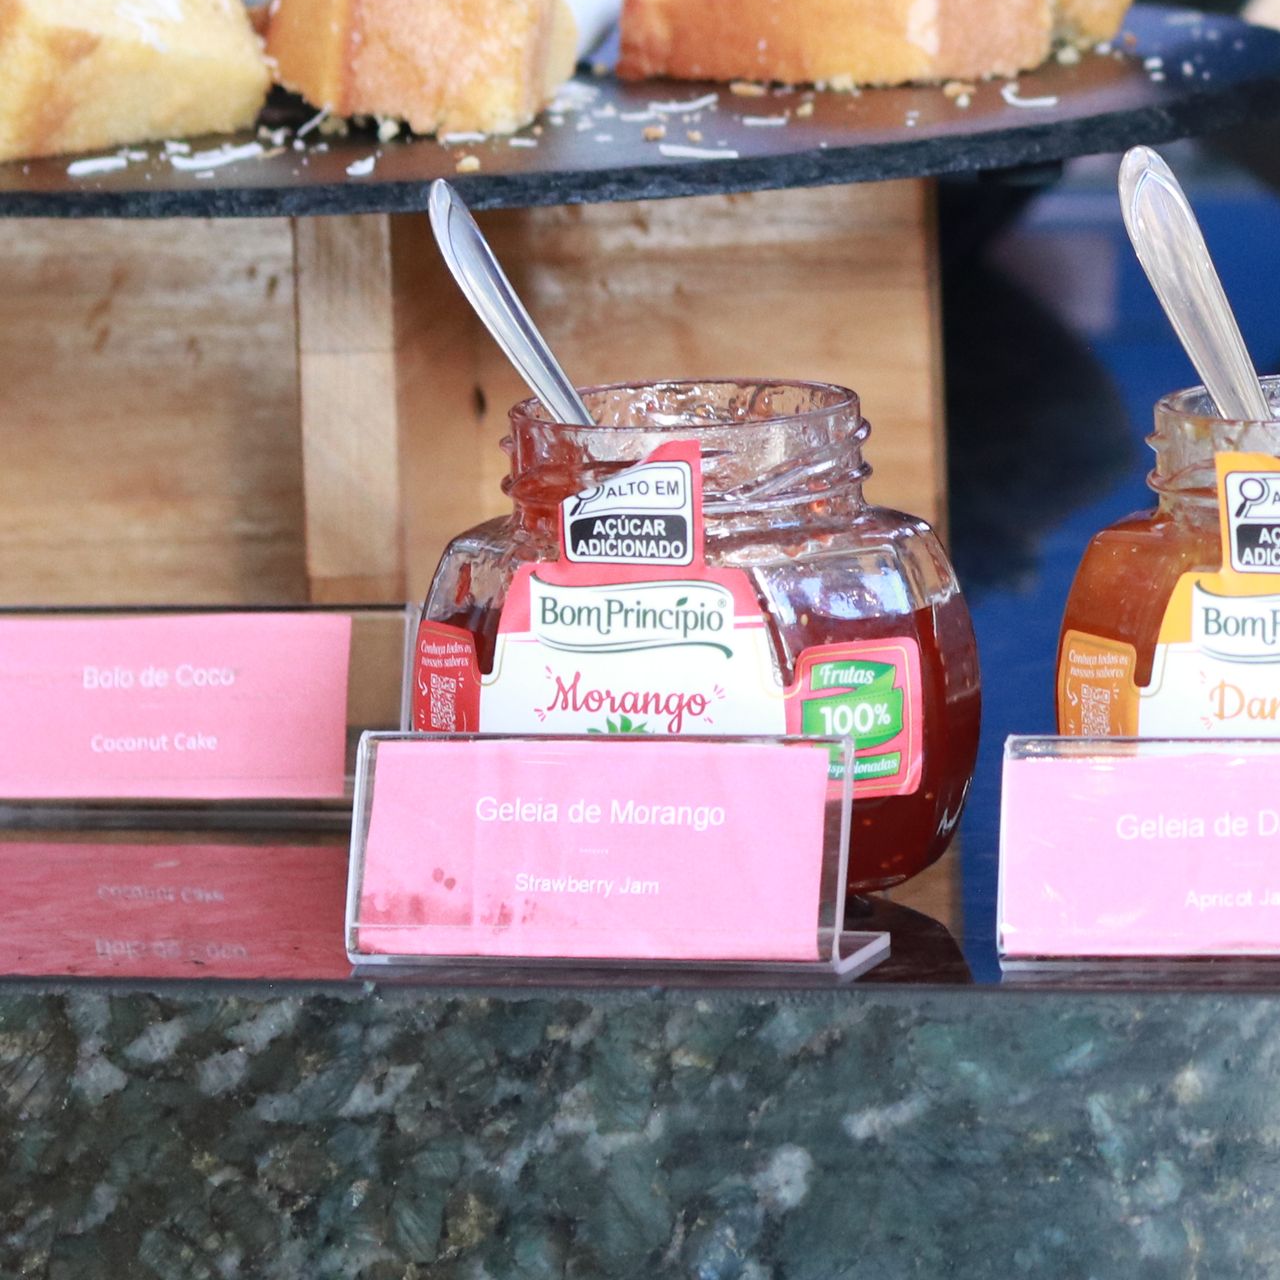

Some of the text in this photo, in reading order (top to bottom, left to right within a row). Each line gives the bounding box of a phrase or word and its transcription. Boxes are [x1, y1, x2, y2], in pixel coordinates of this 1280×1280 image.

[606, 480, 680, 498] ALTO EM
[593, 515, 666, 538] AÇÚCAR
[576, 538, 684, 558] ADICIONADO
[139, 666, 169, 689] de
[175, 663, 235, 688] Coco
[819, 663, 876, 685] Frutas
[546, 670, 712, 734] Morango
[819, 702, 892, 735] 100%
[91, 731, 218, 753] Coconut Cake
[475, 795, 726, 832] Geleia de Morango
[1115, 813, 1206, 840] Geleia
[1213, 812, 1249, 838] de
[515, 872, 660, 899] Strawberry Jam
[1184, 888, 1253, 912] Apricot
